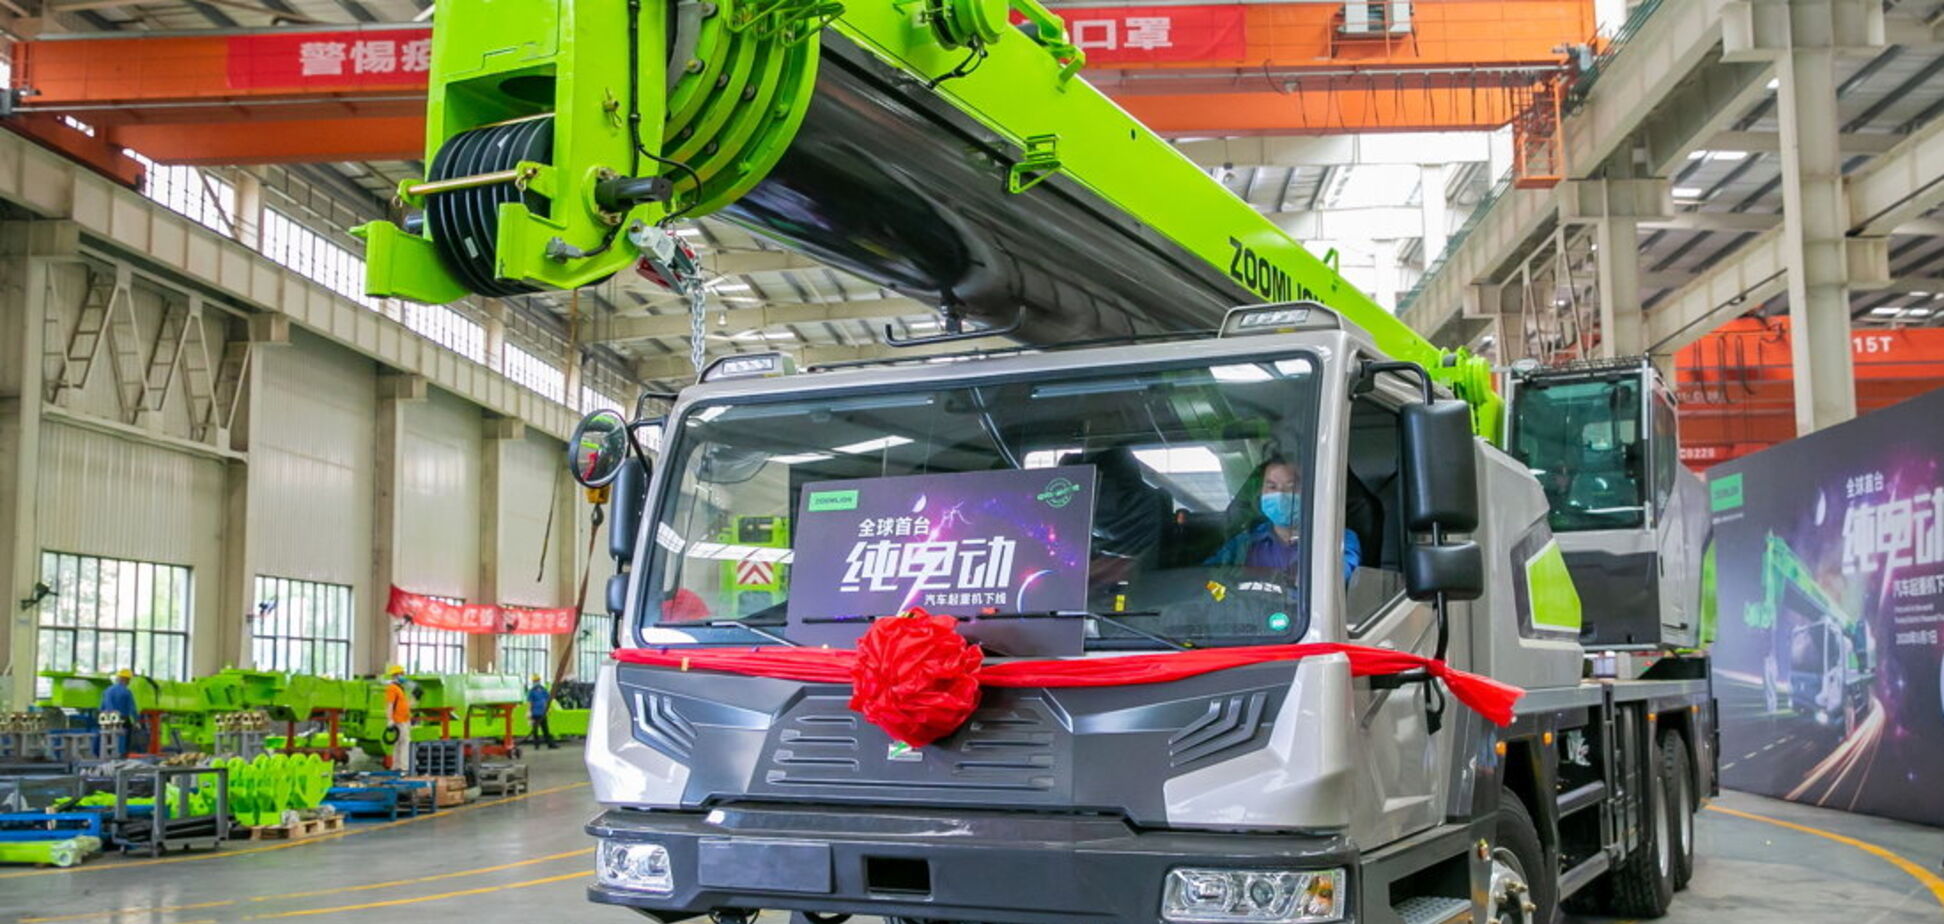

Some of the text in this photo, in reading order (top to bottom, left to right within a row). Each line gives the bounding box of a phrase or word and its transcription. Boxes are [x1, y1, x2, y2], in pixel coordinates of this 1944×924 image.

[1073, 17, 1173, 50] 口罩
[1229, 236, 1324, 304] ZOOMLI
[1852, 336, 1893, 354] 15T
[1846, 470, 1885, 498] 全球首台
[857, 516, 932, 538] 全球首台
[840, 535, 1016, 592] 纯电动
[924, 592, 1007, 606] 汽车起重机下线
